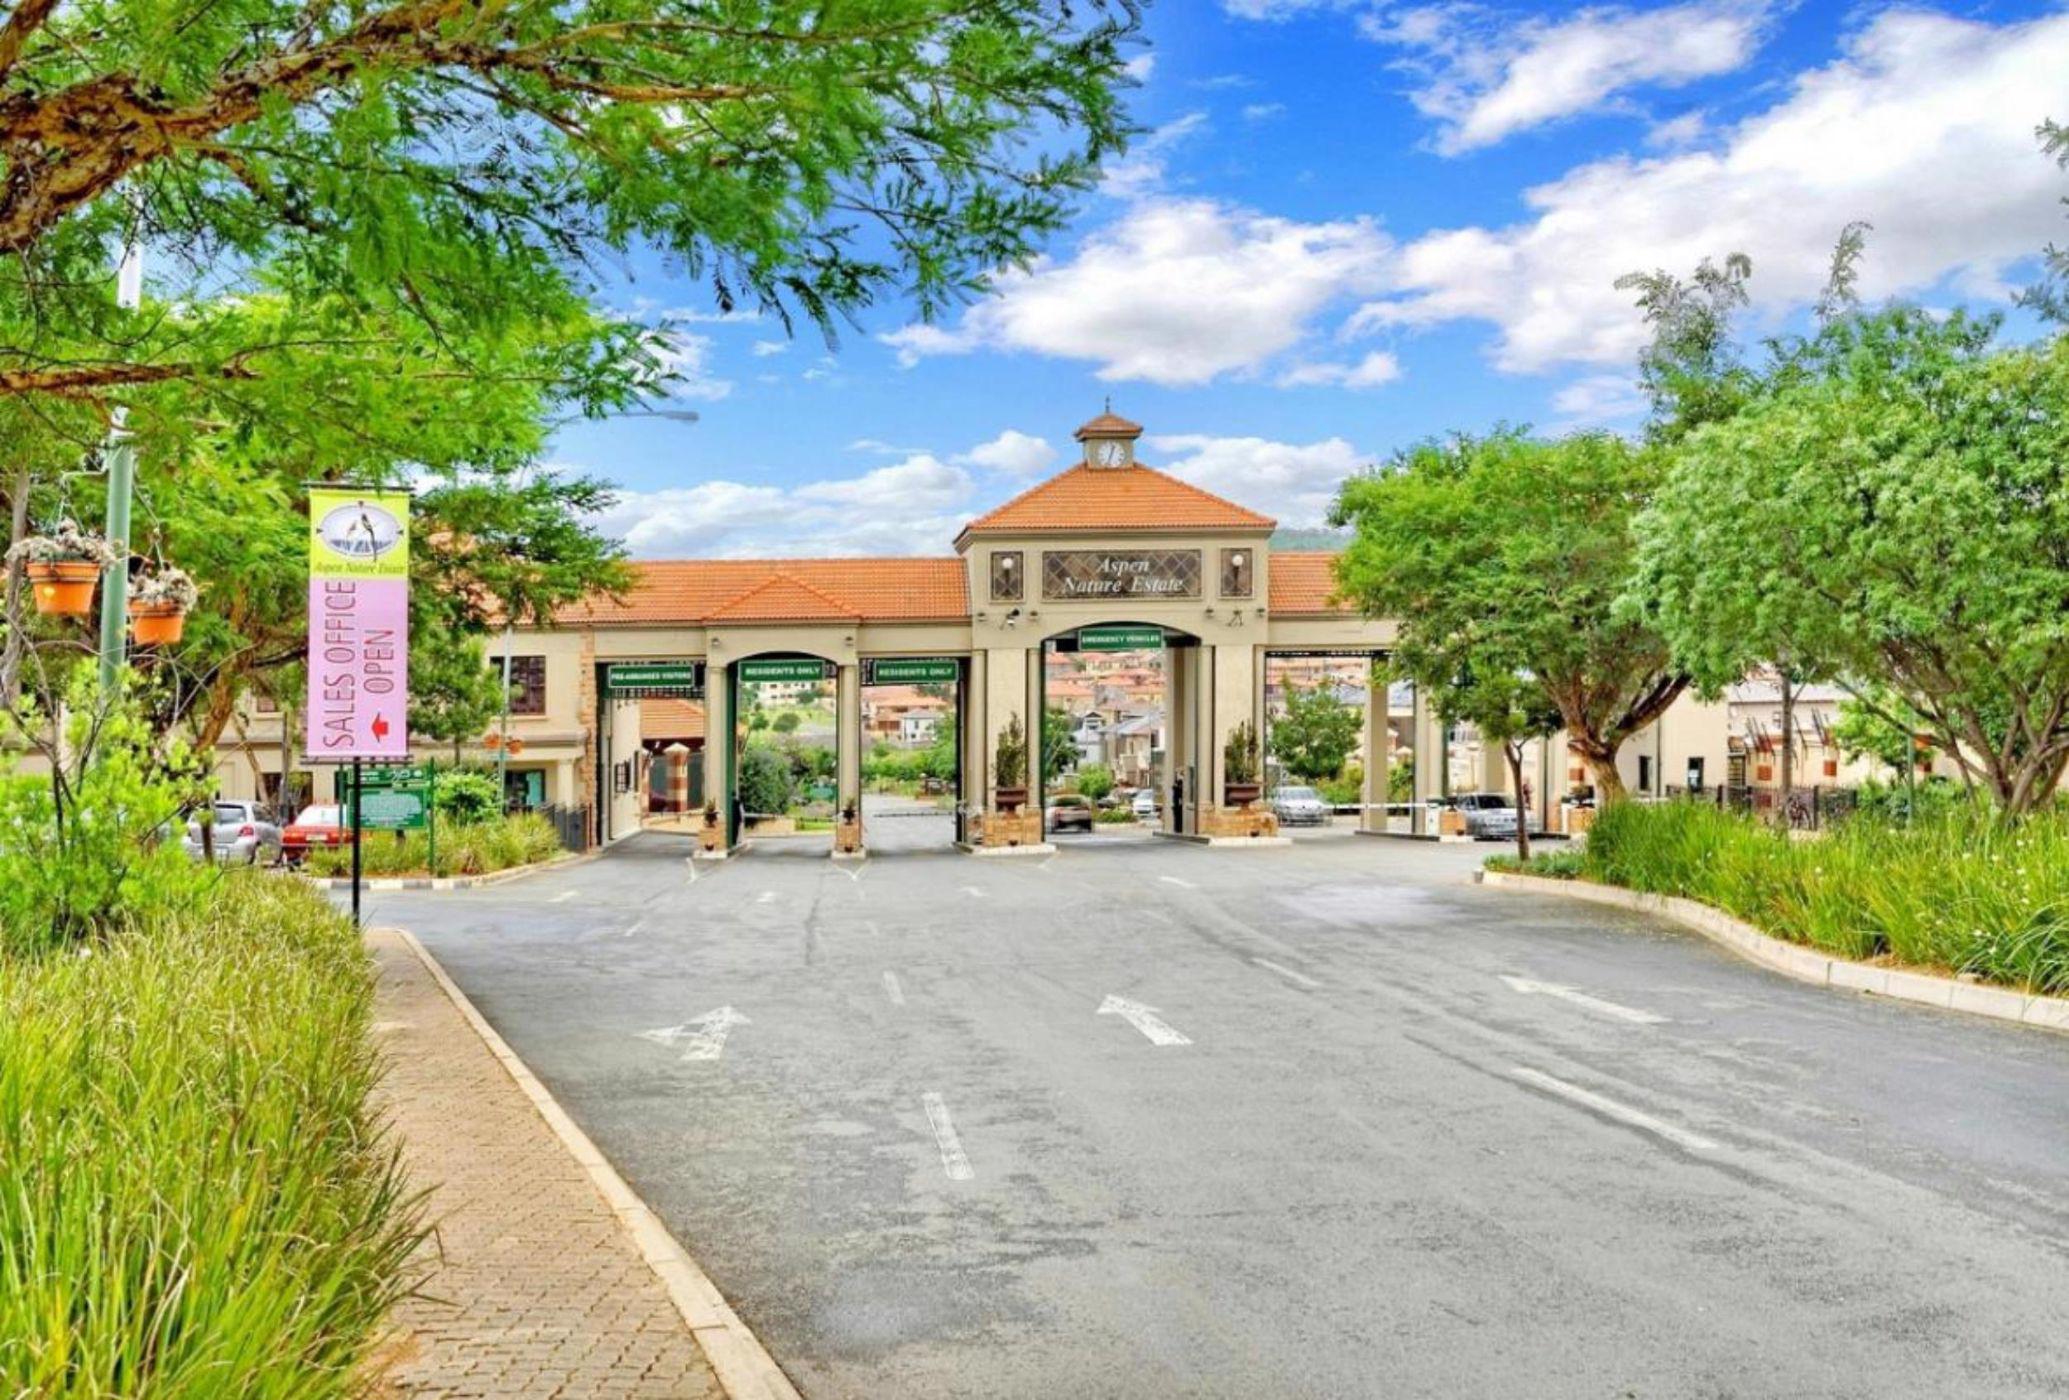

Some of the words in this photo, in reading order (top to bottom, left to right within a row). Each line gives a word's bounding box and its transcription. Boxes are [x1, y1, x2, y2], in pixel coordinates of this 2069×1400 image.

[1098, 557, 1150, 577] Aspen
[1062, 576, 1122, 594] Nature
[1130, 575, 1184, 593] Estate
[324, 581, 356, 664] OFFICE
[363, 629, 395, 694] OPEN
[745, 667, 795, 676] RESIDENTS
[796, 666, 820, 675] ONLY
[878, 668, 927, 677] RESIDENTS
[929, 667, 953, 676] ONLY
[323, 673, 356, 748] SALES
